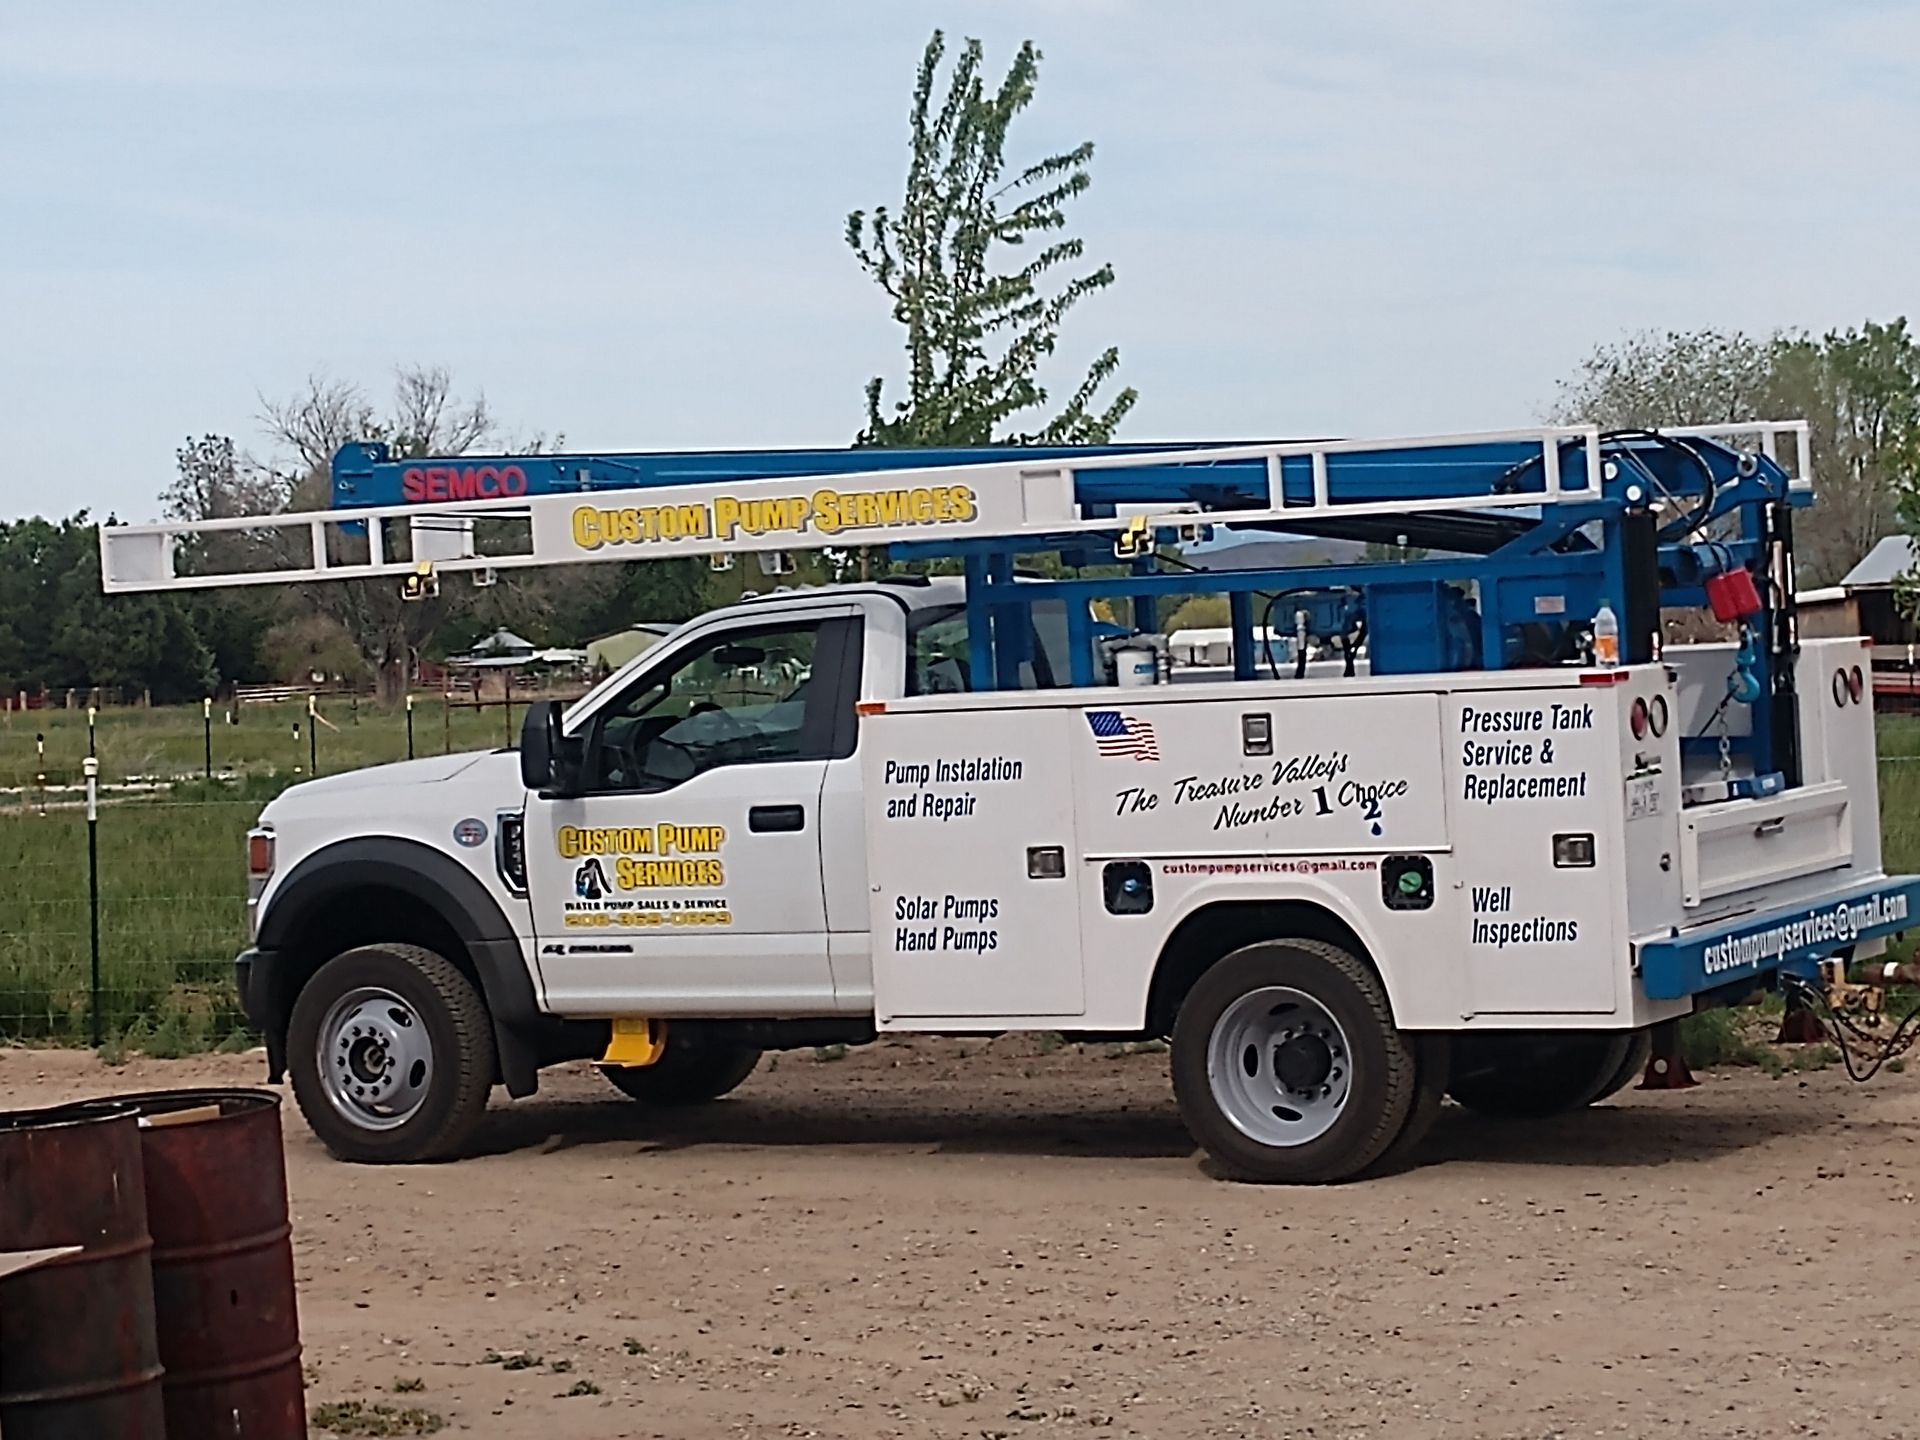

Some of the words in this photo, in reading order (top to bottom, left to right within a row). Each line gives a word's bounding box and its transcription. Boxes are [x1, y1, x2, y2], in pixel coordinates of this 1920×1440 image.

[403, 465, 526, 502] SEMCO
[572, 504, 706, 549] CUSTOM
[714, 496, 811, 541] PUMP
[811, 485, 978, 534] SERVICES
[1461, 707, 1543, 733] Pressure
[1551, 703, 1593, 730] Tank
[1462, 740, 1532, 767] Service
[1540, 738, 1554, 764] &
[885, 760, 929, 789] Pump
[936, 755, 1022, 784] Instalation
[1116, 787, 1159, 815] The
[1173, 772, 1264, 805] Treasure
[1213, 795, 1305, 830] Number
[1312, 786, 1334, 815] 1
[1337, 779, 1408, 807] Choice
[1464, 772, 1586, 805] Replacement
[887, 794, 918, 818] and
[923, 792, 976, 821] Repair
[559, 826, 652, 859] CUSTOM
[657, 823, 725, 856] PUMP
[616, 857, 724, 890] SERVICES
[1162, 859, 1378, 875] custompumpservices@gmail.com
[564, 901, 600, 911] WATER
[604, 901, 634, 910] PUMP
[638, 900, 669, 910] SALES
[673, 901, 681, 909] &
[685, 899, 727, 909] SERVICE
[895, 895, 938, 921] Solar
[942, 894, 999, 924] Pumps
[1472, 886, 1511, 913] Well
[895, 927, 937, 952] Hand
[943, 925, 998, 955] Pumps
[1473, 916, 1578, 948] Inspections
[1704, 893, 1908, 974] custompumpservices@gmail.com
